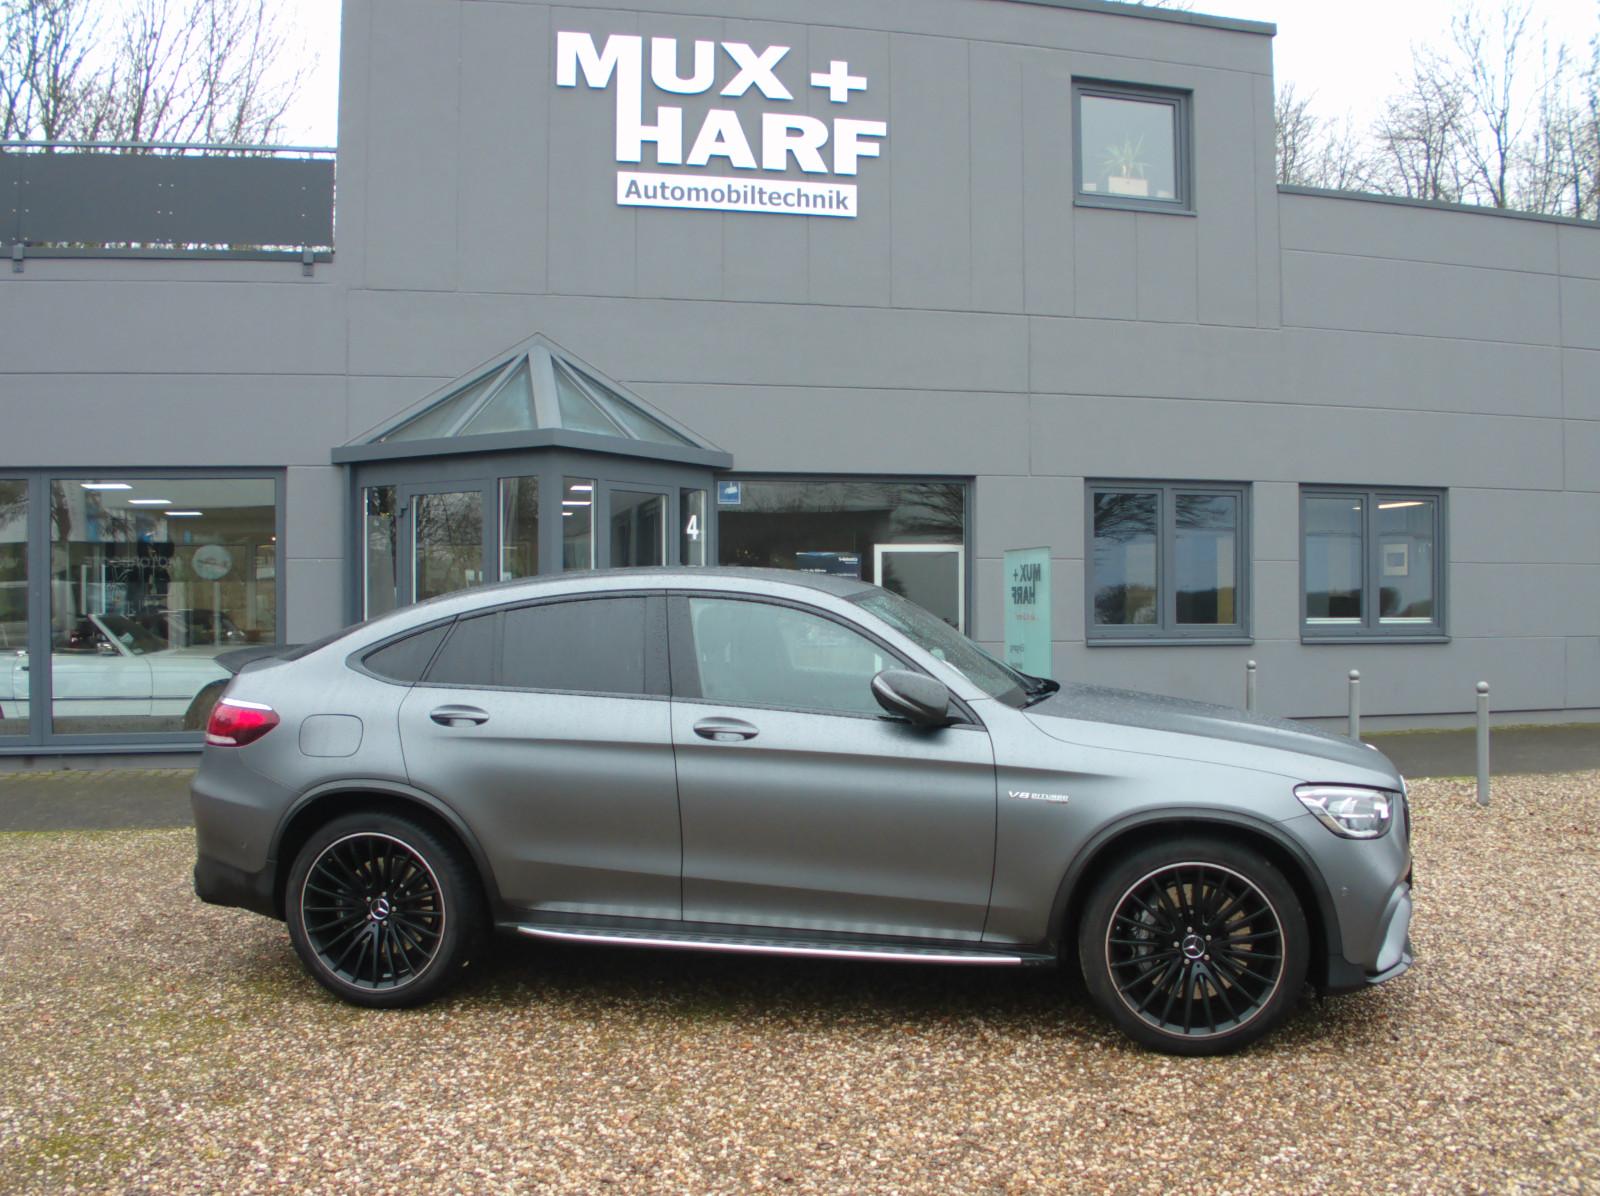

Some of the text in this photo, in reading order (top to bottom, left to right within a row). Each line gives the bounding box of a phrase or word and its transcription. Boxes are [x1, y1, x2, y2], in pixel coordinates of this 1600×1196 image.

[556, 31, 794, 101] MUX
[616, 106, 887, 175] HARF
[624, 179, 849, 211] Automobiltechnik
[686, 514, 699, 540] 4
[1008, 790, 1030, 799] V8
